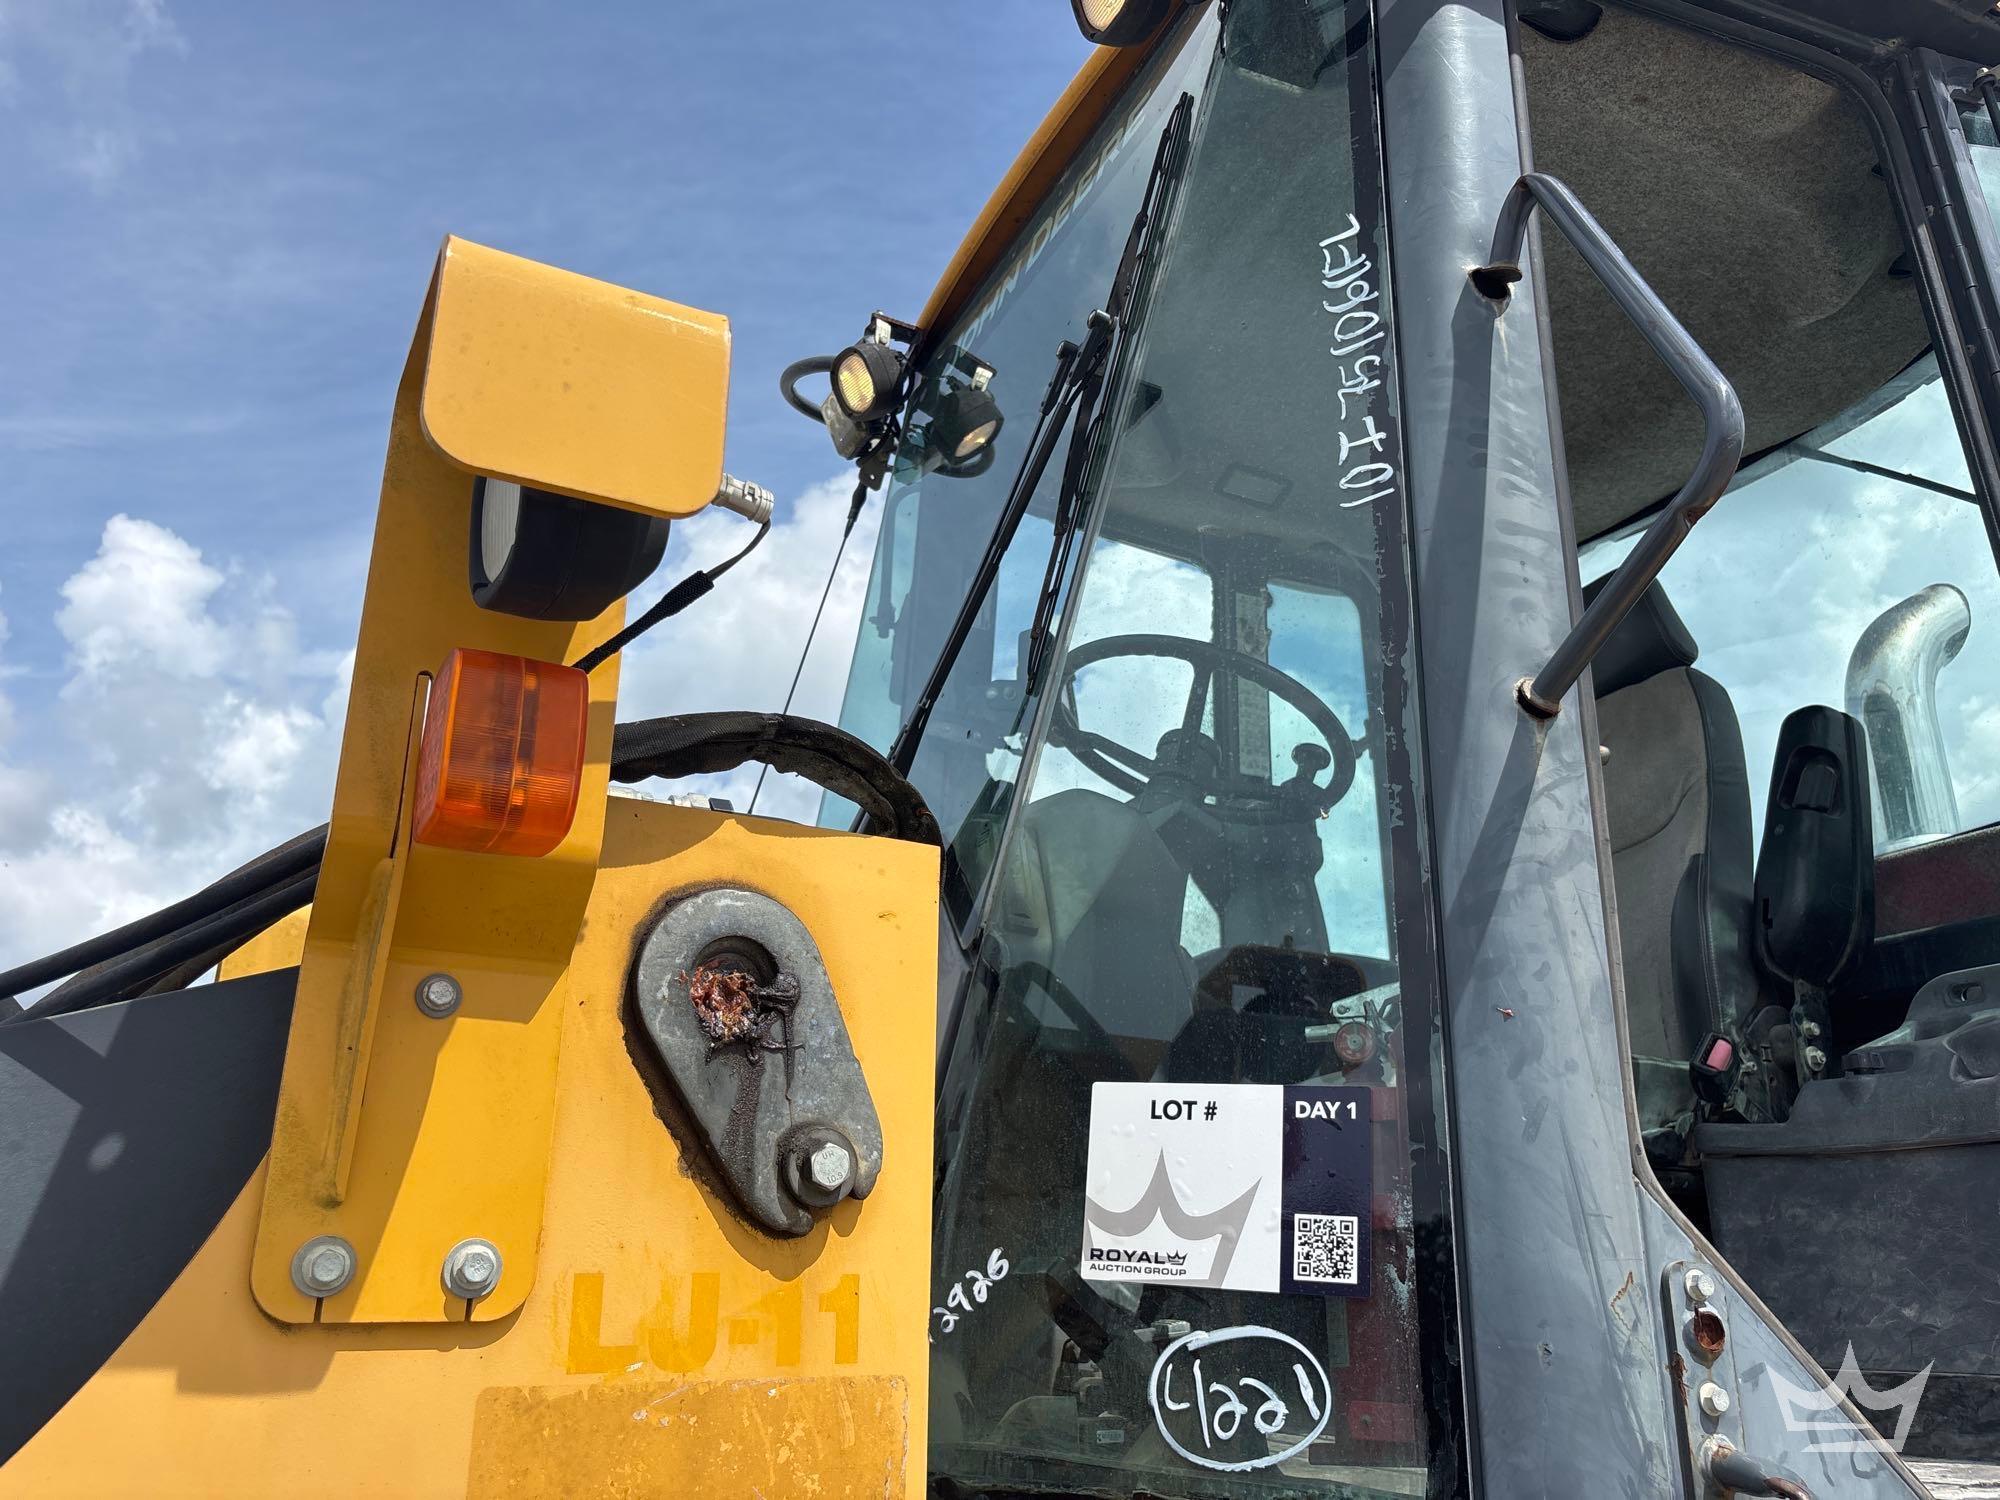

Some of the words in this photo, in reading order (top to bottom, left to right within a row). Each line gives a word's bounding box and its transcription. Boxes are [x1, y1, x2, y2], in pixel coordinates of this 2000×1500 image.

[1025, 88, 1152, 273] DEERE
[1150, 1099, 1198, 1121] LOT
[1203, 1100, 1218, 1121] #
[1294, 1100, 1341, 1119] DAY
[1347, 1101, 1357, 1119] 1
[1089, 1247, 1166, 1266] ROYAL
[1089, 1262, 1143, 1275] AUCTION
[1144, 1265, 1187, 1277] GROUP
[927, 1243, 1010, 1342] 2926
